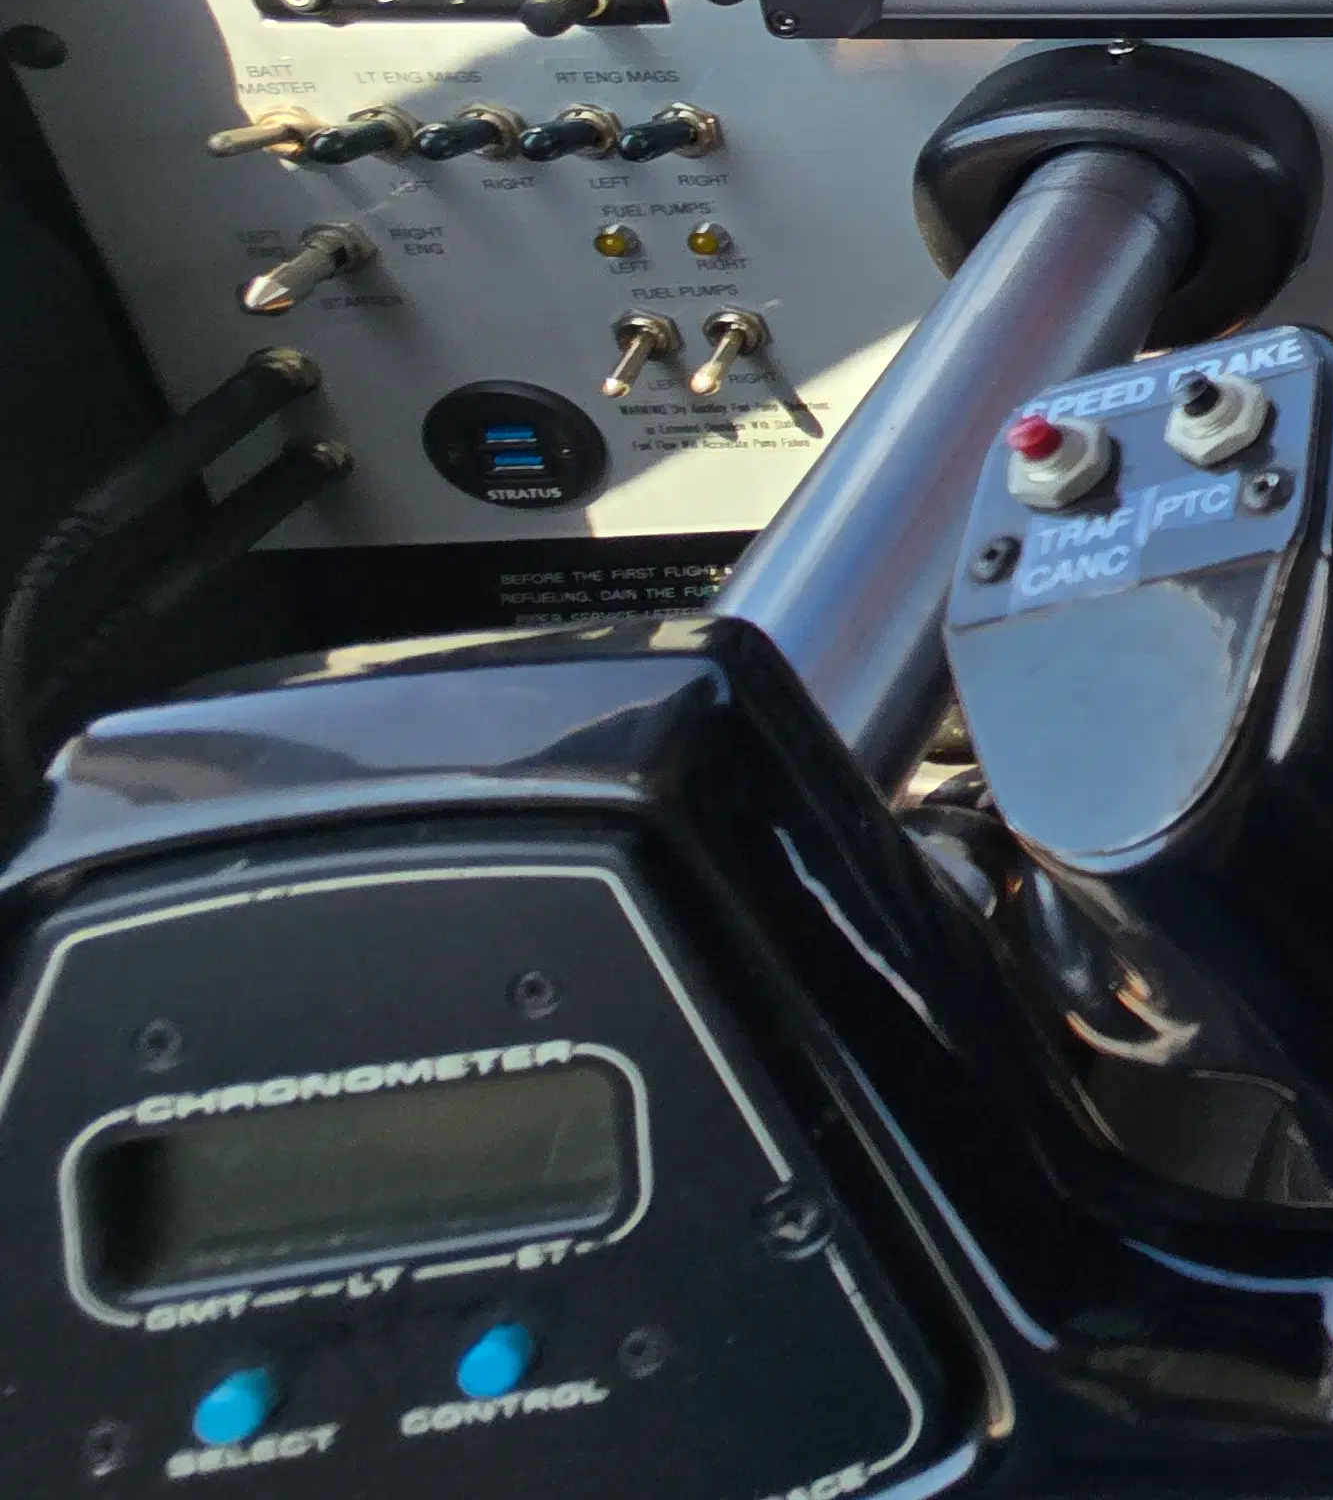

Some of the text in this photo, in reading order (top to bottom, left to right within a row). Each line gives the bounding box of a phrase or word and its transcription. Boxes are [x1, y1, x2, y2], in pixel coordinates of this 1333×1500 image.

[556, 71, 680, 84] RT ENG MAGS
[483, 177, 535, 190] RIGHT
[601, 203, 711, 217] FUEL PUMPS
[486, 487, 562, 500] STRATUS
[1153, 484, 1232, 525] PTC
[1019, 546, 1131, 596] CANC
[133, 1040, 577, 1125] CHRONOMETER
[146, 1293, 250, 1331] GMT
[400, 1380, 609, 1436] CONTROL
[164, 1424, 341, 1479] SELECT
